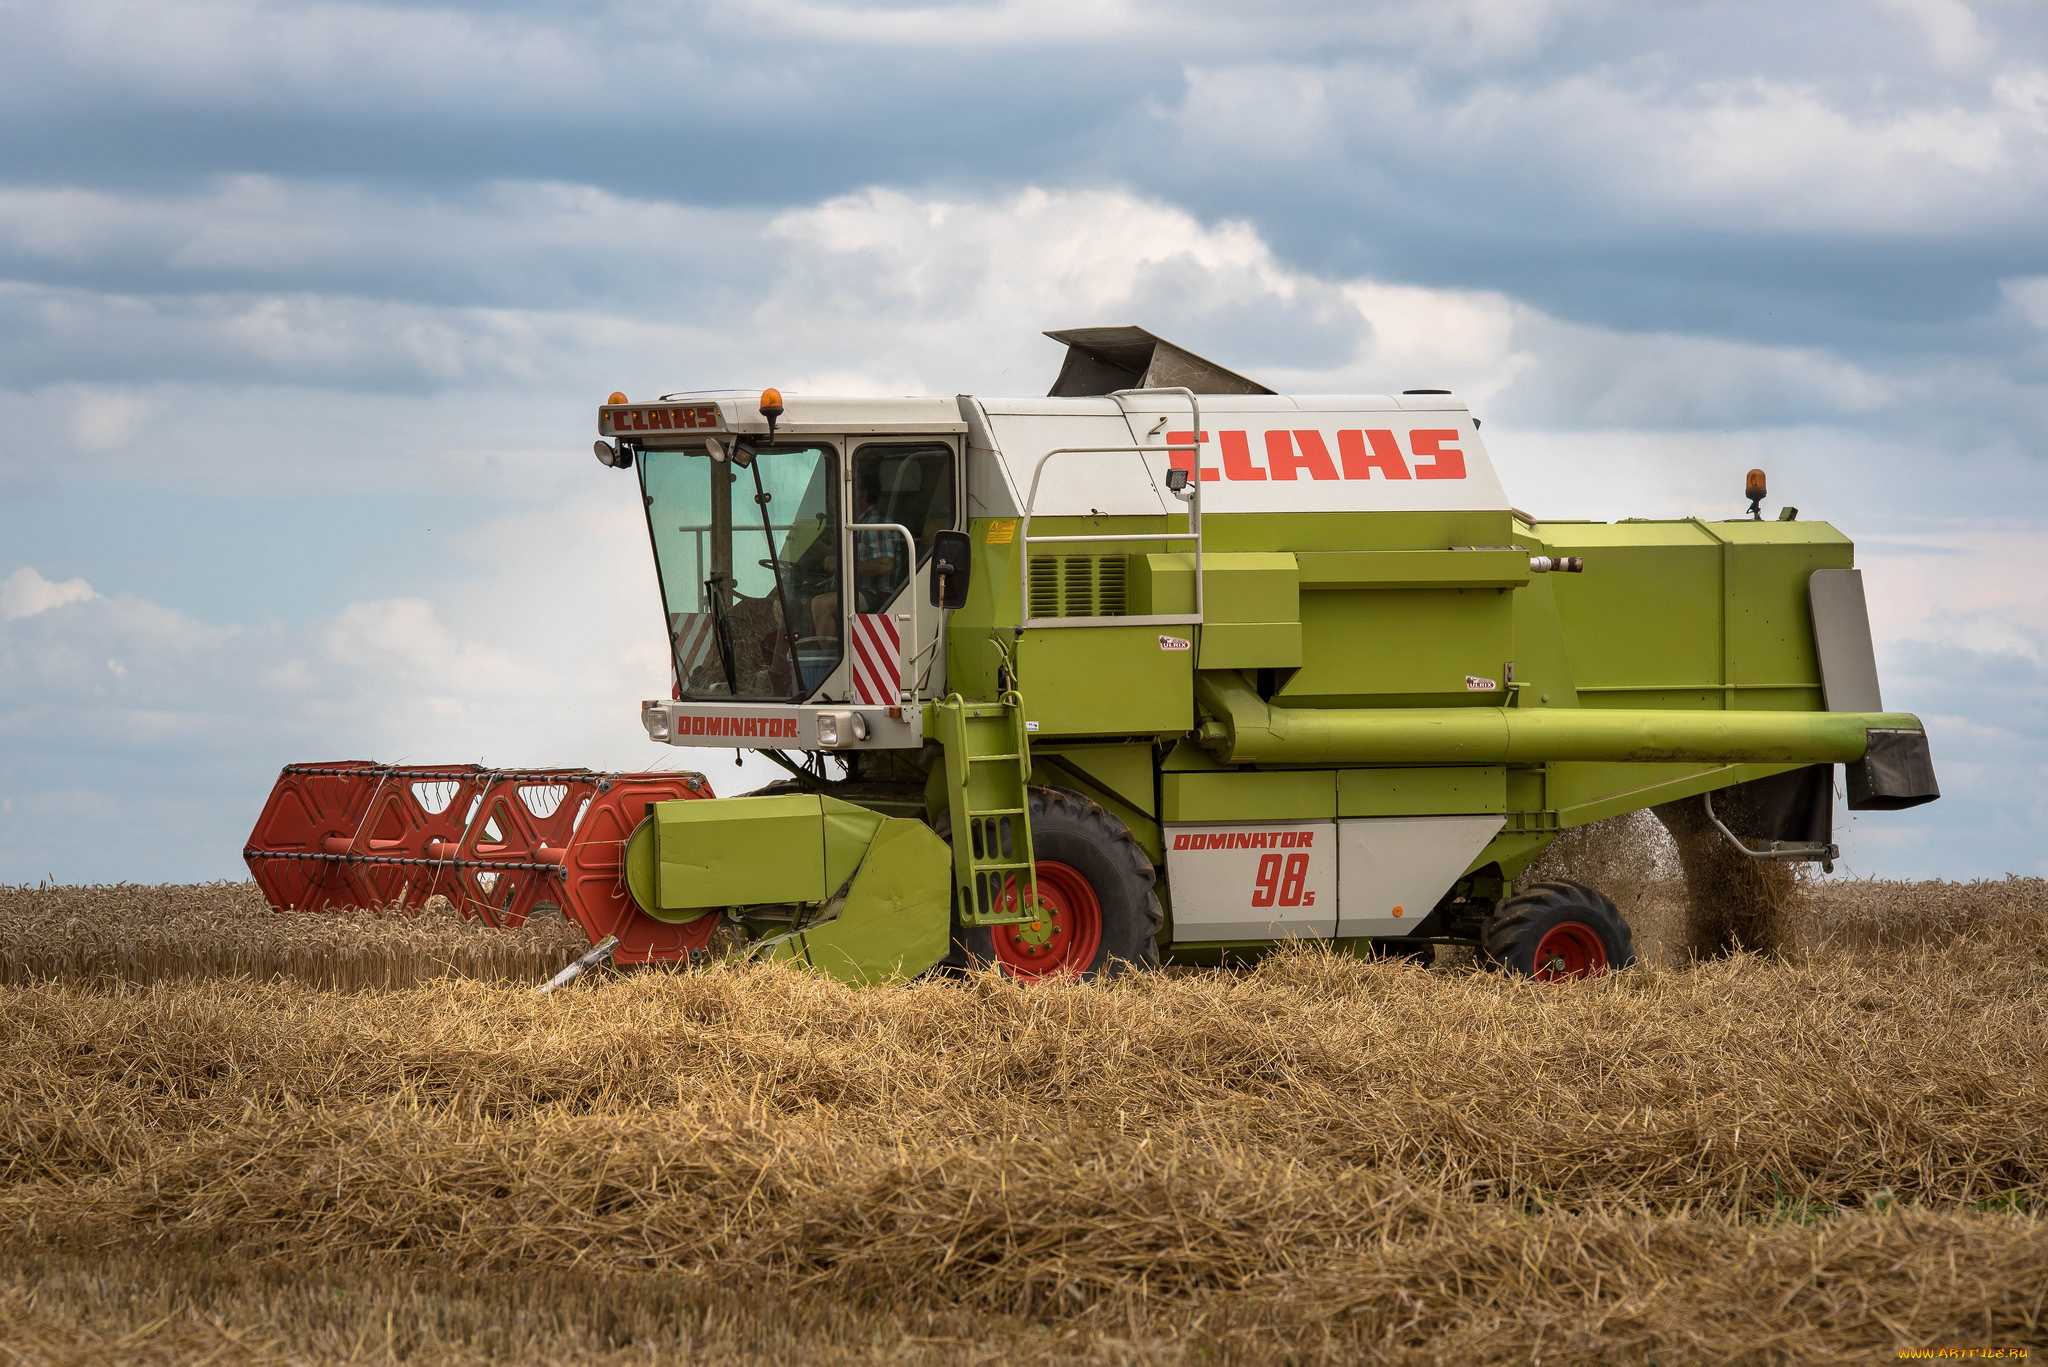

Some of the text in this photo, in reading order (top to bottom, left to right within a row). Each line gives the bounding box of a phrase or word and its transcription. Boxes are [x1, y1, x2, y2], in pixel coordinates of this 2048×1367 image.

[613, 407, 717, 431] CLAAS
[1166, 429, 1466, 481] CLAAS
[678, 716, 798, 738] DOMINATOR
[1173, 832, 1314, 850] DOMINATOR
